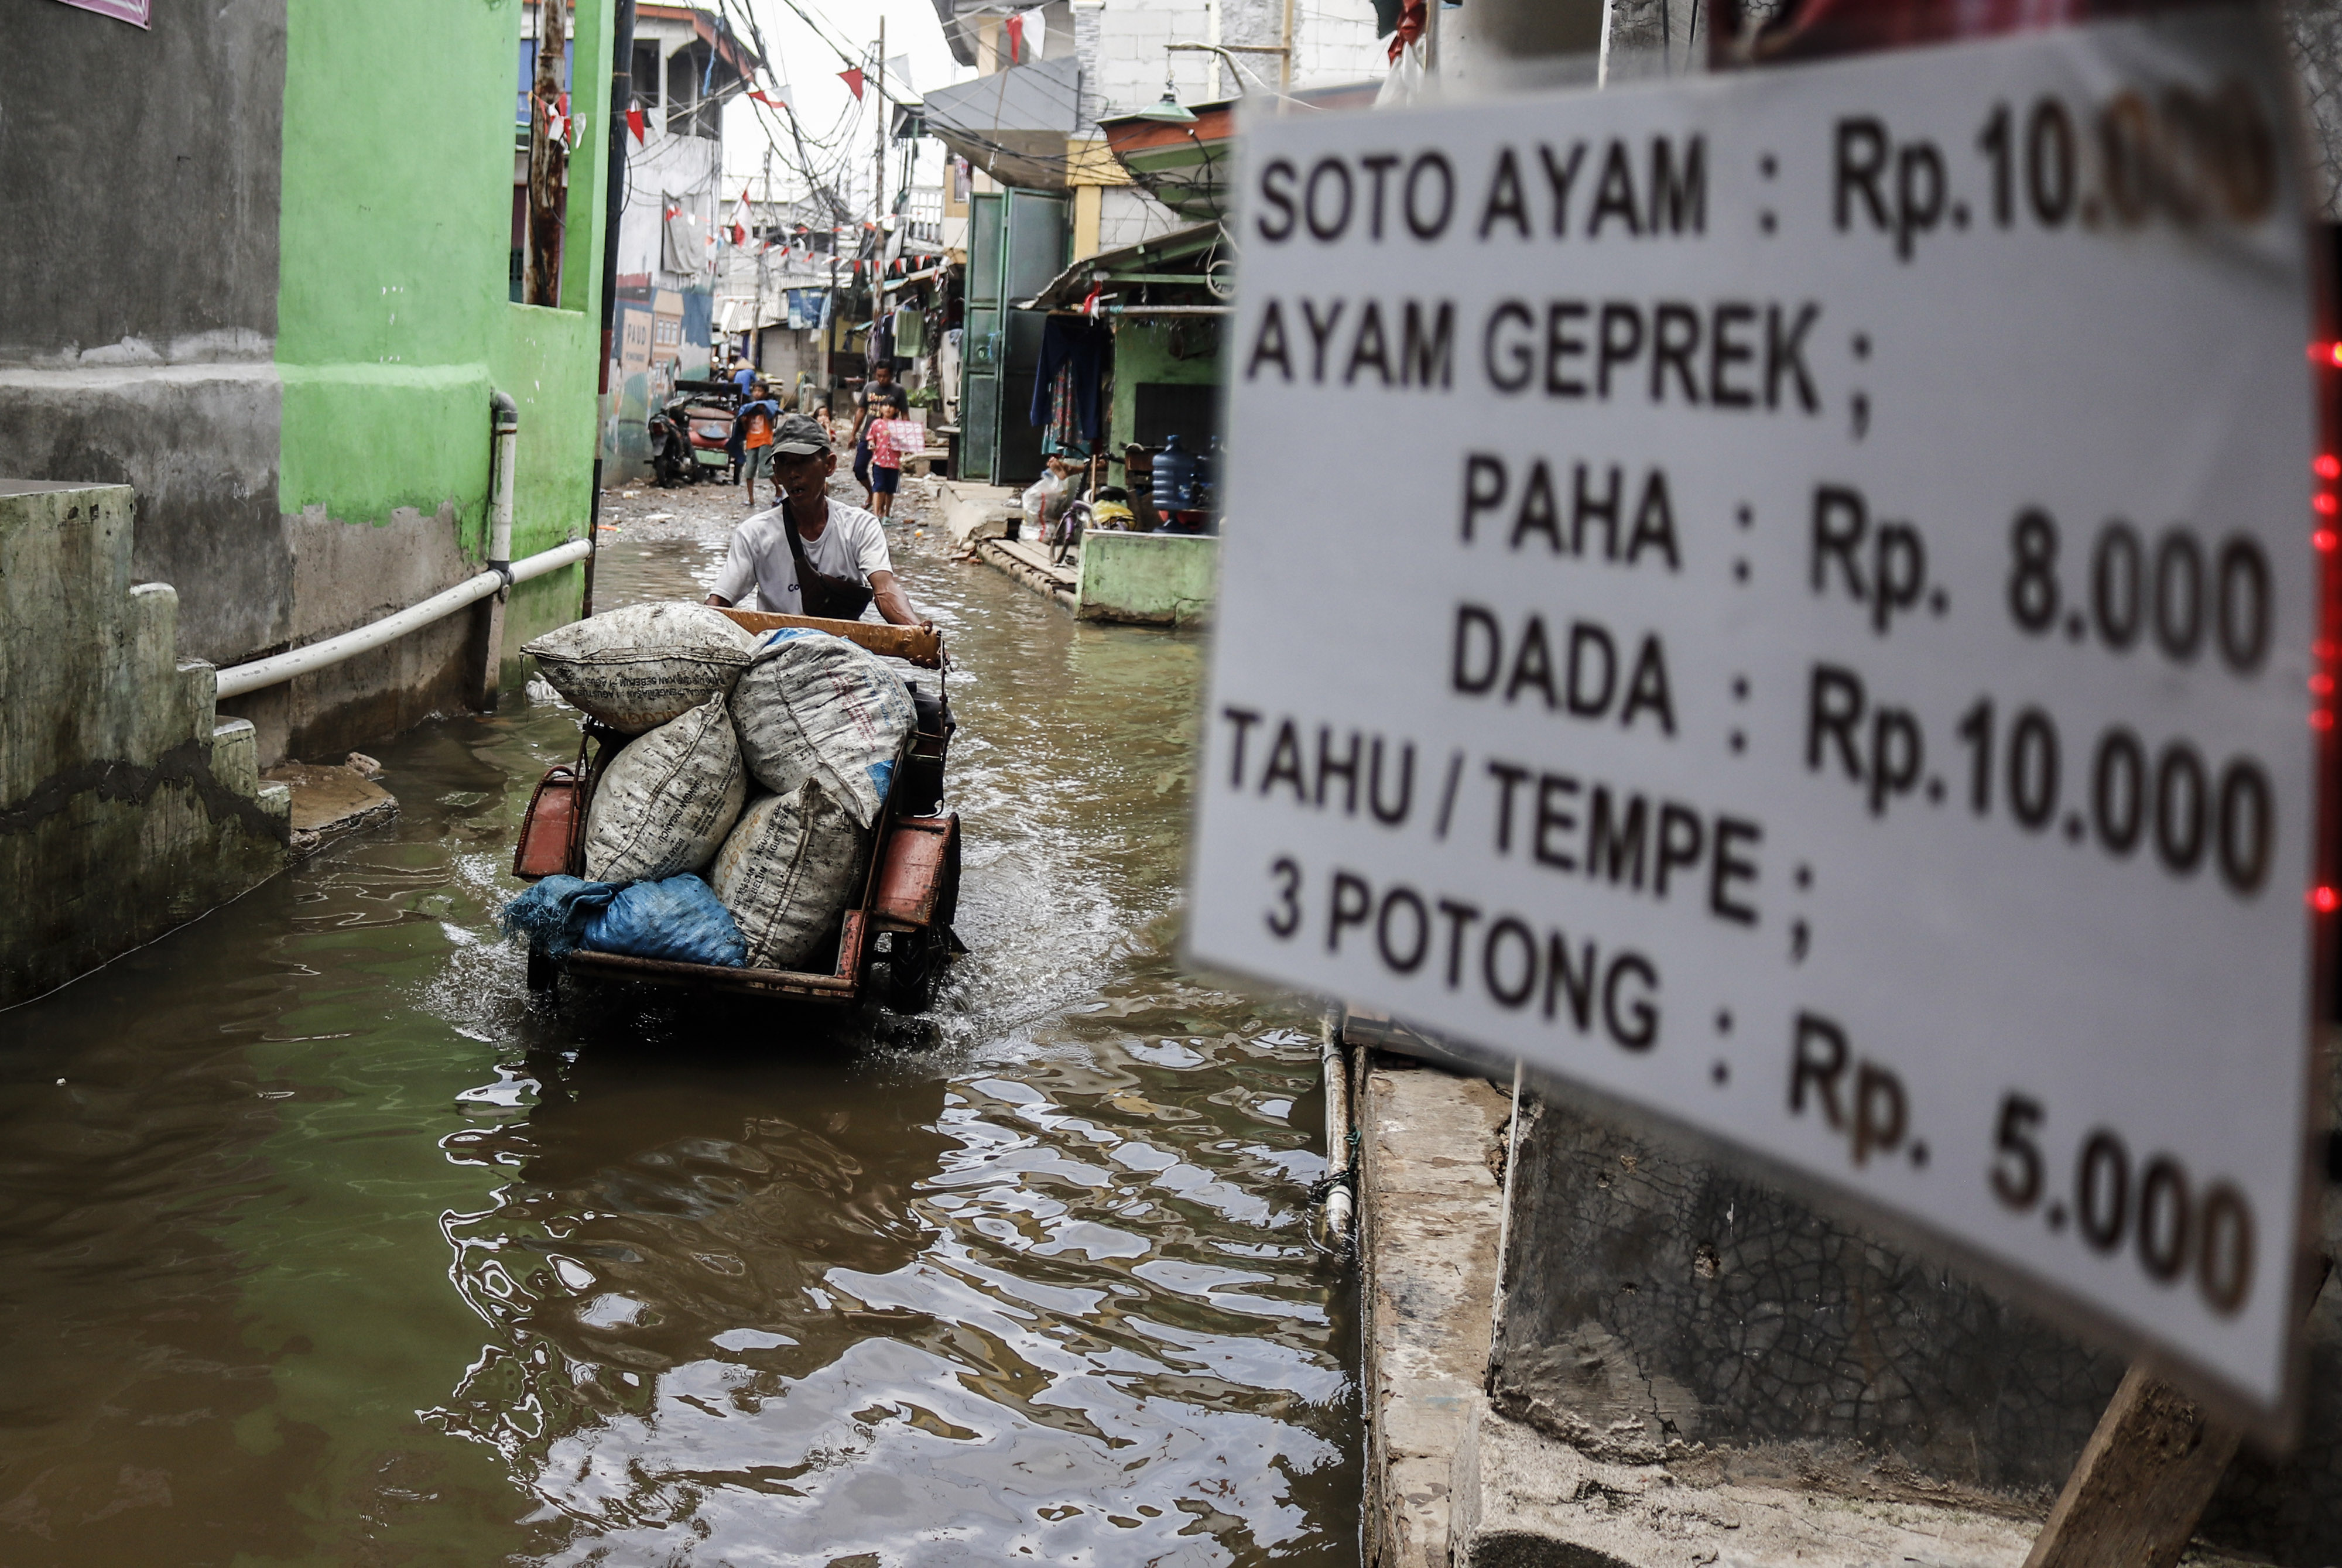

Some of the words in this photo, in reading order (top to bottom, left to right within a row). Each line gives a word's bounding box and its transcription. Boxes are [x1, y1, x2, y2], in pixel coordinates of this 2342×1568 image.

[1256, 150, 1458, 245] SOTO
[1476, 129, 1707, 239] AYAM
[628, 324, 646, 345] PAUD
[1244, 296, 1456, 391] AYAM
[1481, 300, 1822, 415] GEPREK
[1460, 451, 1682, 573] PAHA
[1809, 482, 1950, 635] Rp.
[2007, 502, 2274, 677] 8.000
[1224, 708, 1415, 826] TAHU
[1484, 760, 1762, 925] TEMPE
[1452, 602, 1677, 738] DADA
[1805, 662, 2276, 898] Rp.10.000
[1266, 858, 1302, 938] 3
[1325, 868, 1660, 1052] POTONG
[1789, 1010, 1930, 1169] Rp.
[1990, 1088, 2257, 1320] 5.000
